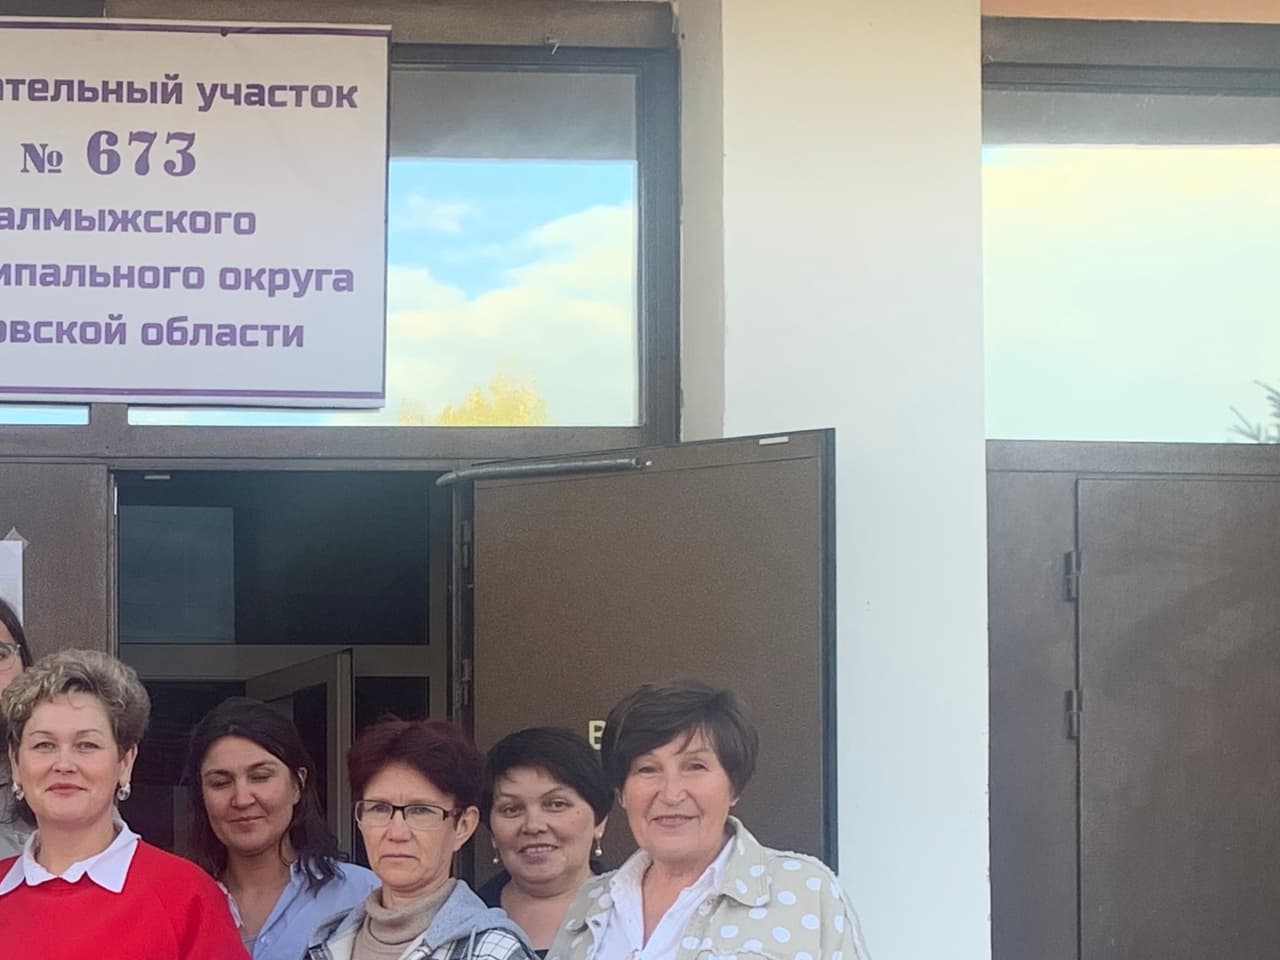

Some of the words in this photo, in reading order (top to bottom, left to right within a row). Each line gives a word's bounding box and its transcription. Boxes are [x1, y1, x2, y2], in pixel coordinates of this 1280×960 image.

[196, 79, 358, 112] участок
[21, 142, 63, 174] №
[86, 130, 196, 176] 673
[219, 265, 354, 297] округа
[141, 316, 304, 348] области
